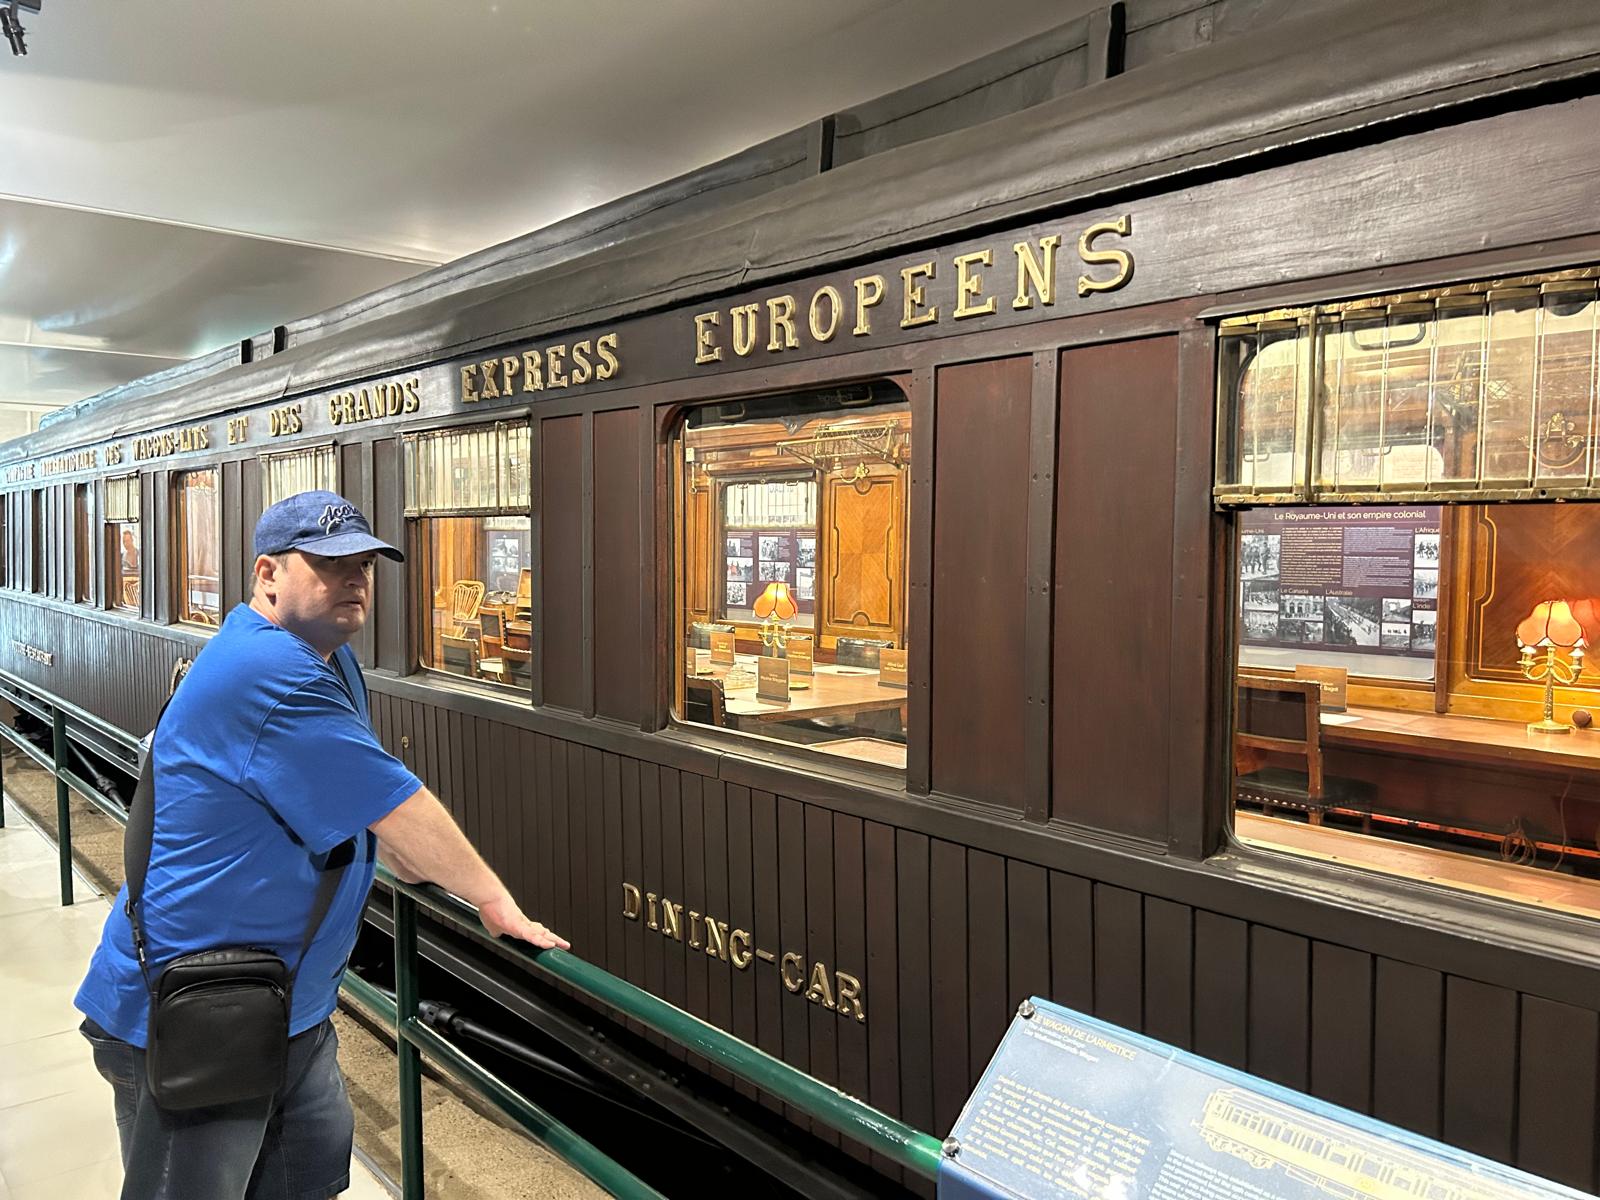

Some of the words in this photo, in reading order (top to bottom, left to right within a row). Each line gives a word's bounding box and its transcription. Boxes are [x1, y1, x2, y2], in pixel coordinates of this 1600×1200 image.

[133, 425, 208, 460] WAGONS-LITS
[227, 415, 248, 445] ET
[268, 404, 302, 436] DES
[328, 378, 419, 425] GRANDS
[460, 333, 618, 403] EXPRESS
[694, 214, 1135, 365] EUROPEENS
[1274, 512, 1284, 520] Le
[1285, 511, 1336, 522] Royaume-Uni
[1337, 511, 1346, 519] et
[1362, 511, 1392, 521] empire
[1393, 510, 1426, 519] colonial
[622, 882, 865, 1022] DINING-CAR
[1031, 1013, 1043, 1024] LE
[1042, 1017, 1074, 1037] WAGON
[1072, 1029, 1087, 1040] DE
[1086, 1033, 1137, 1061] L'ARMISTICE
